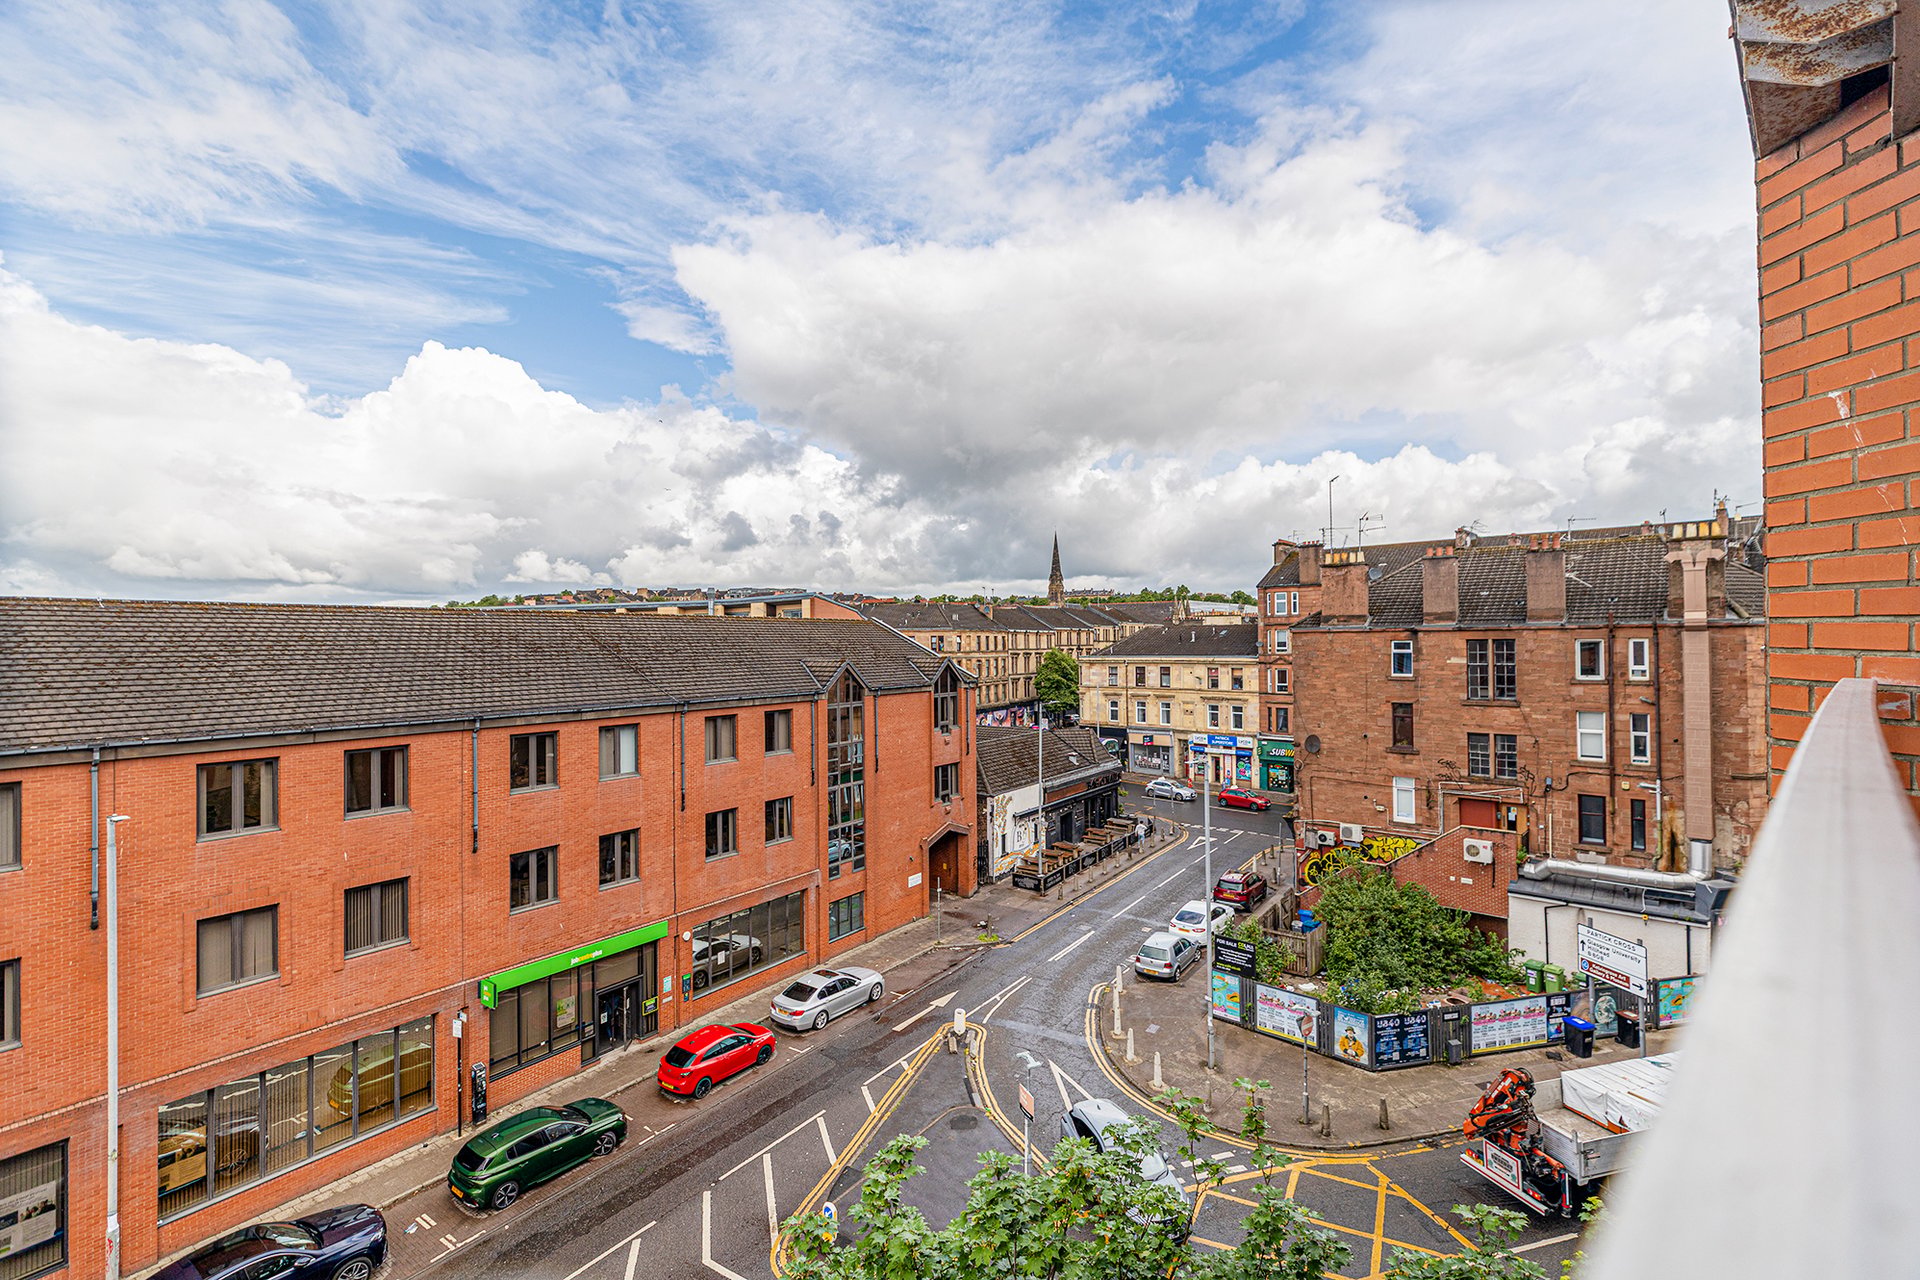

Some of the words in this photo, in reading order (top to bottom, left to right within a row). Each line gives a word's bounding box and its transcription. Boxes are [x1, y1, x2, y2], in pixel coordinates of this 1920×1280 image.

[1226, 940, 1237, 948] SALE
[1586, 929, 1612, 943] PARTICK
[1613, 939, 1636, 951] CROSS
[1587, 938, 1610, 951] Glasgow
[1611, 948, 1641, 964] University
[1587, 945, 1610, 958] Hillhead
[1589, 967, 1606, 978] Gallery
[1610, 976, 1630, 987] Museum
[1376, 1018, 1400, 1028] UB40
[1404, 1015, 1427, 1025] UB40
